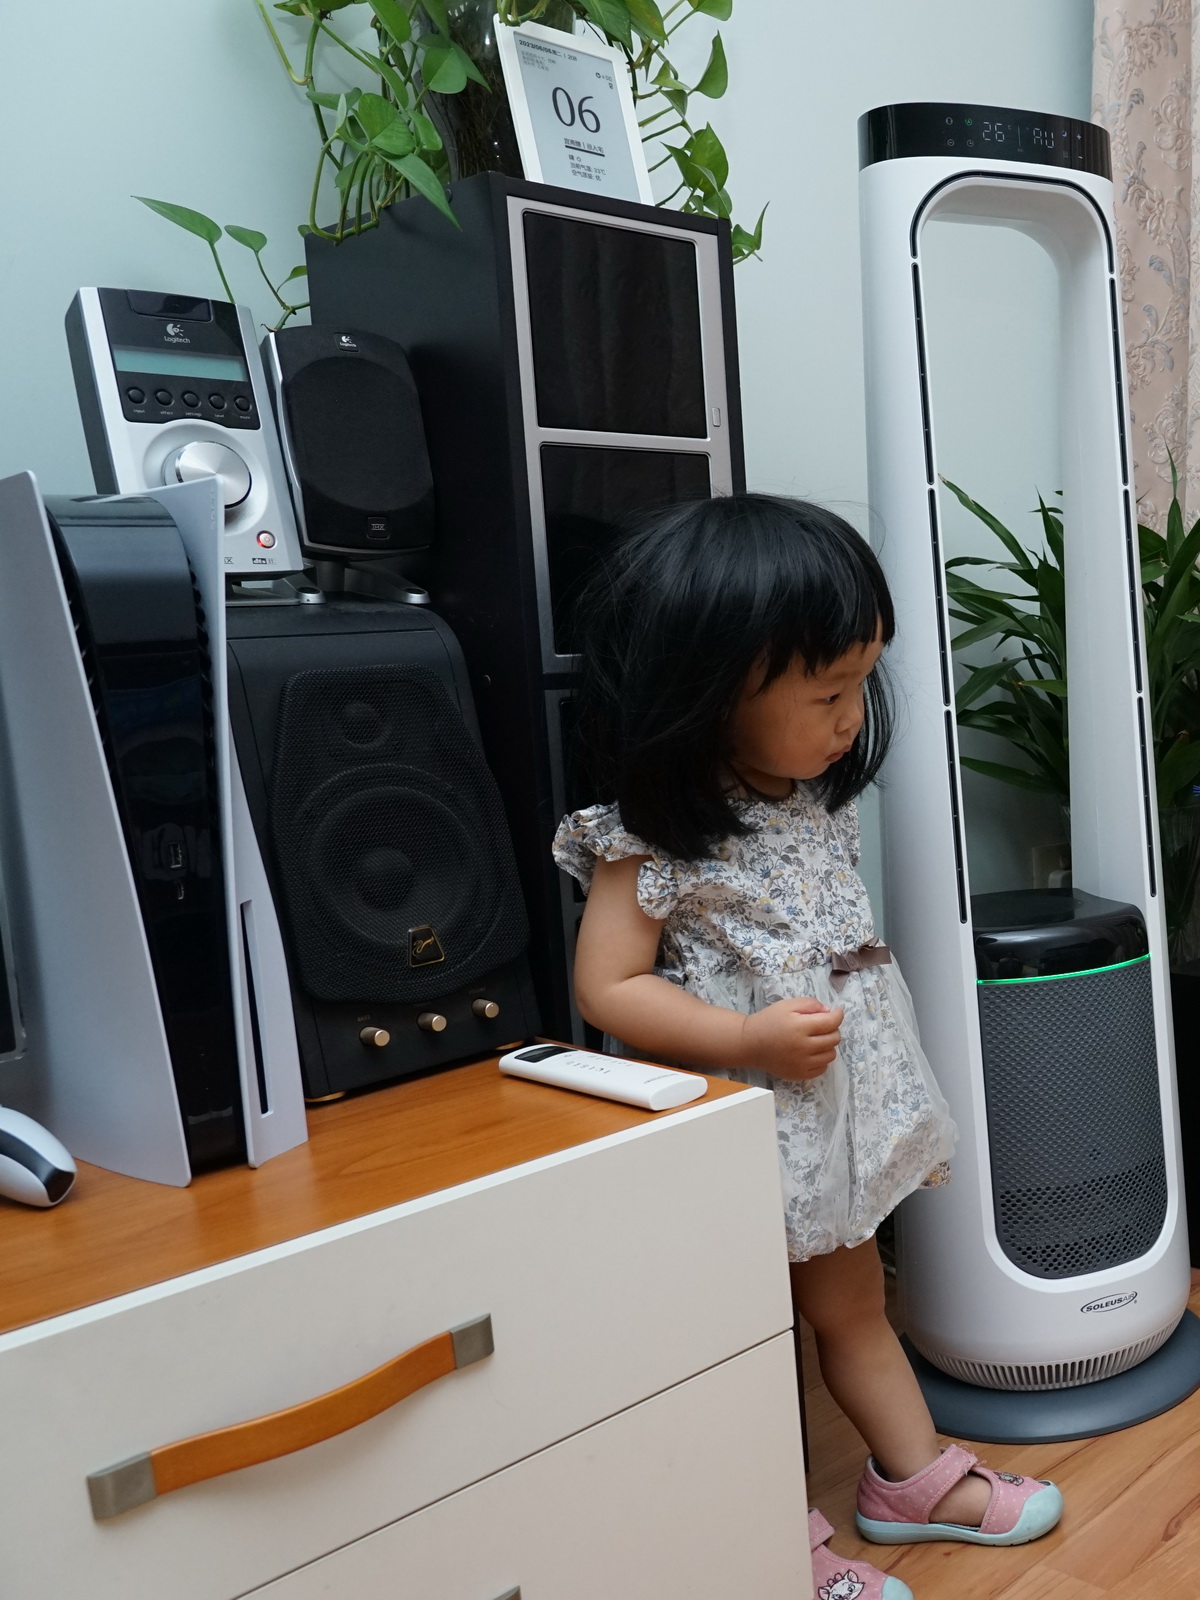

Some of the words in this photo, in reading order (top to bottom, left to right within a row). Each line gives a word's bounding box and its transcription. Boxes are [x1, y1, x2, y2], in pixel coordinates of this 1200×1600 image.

[552, 86, 601, 134] 06
[982, 121, 1005, 143] 26
[164, 335, 191, 344] Logitech
[371, 523, 386, 531] THX
